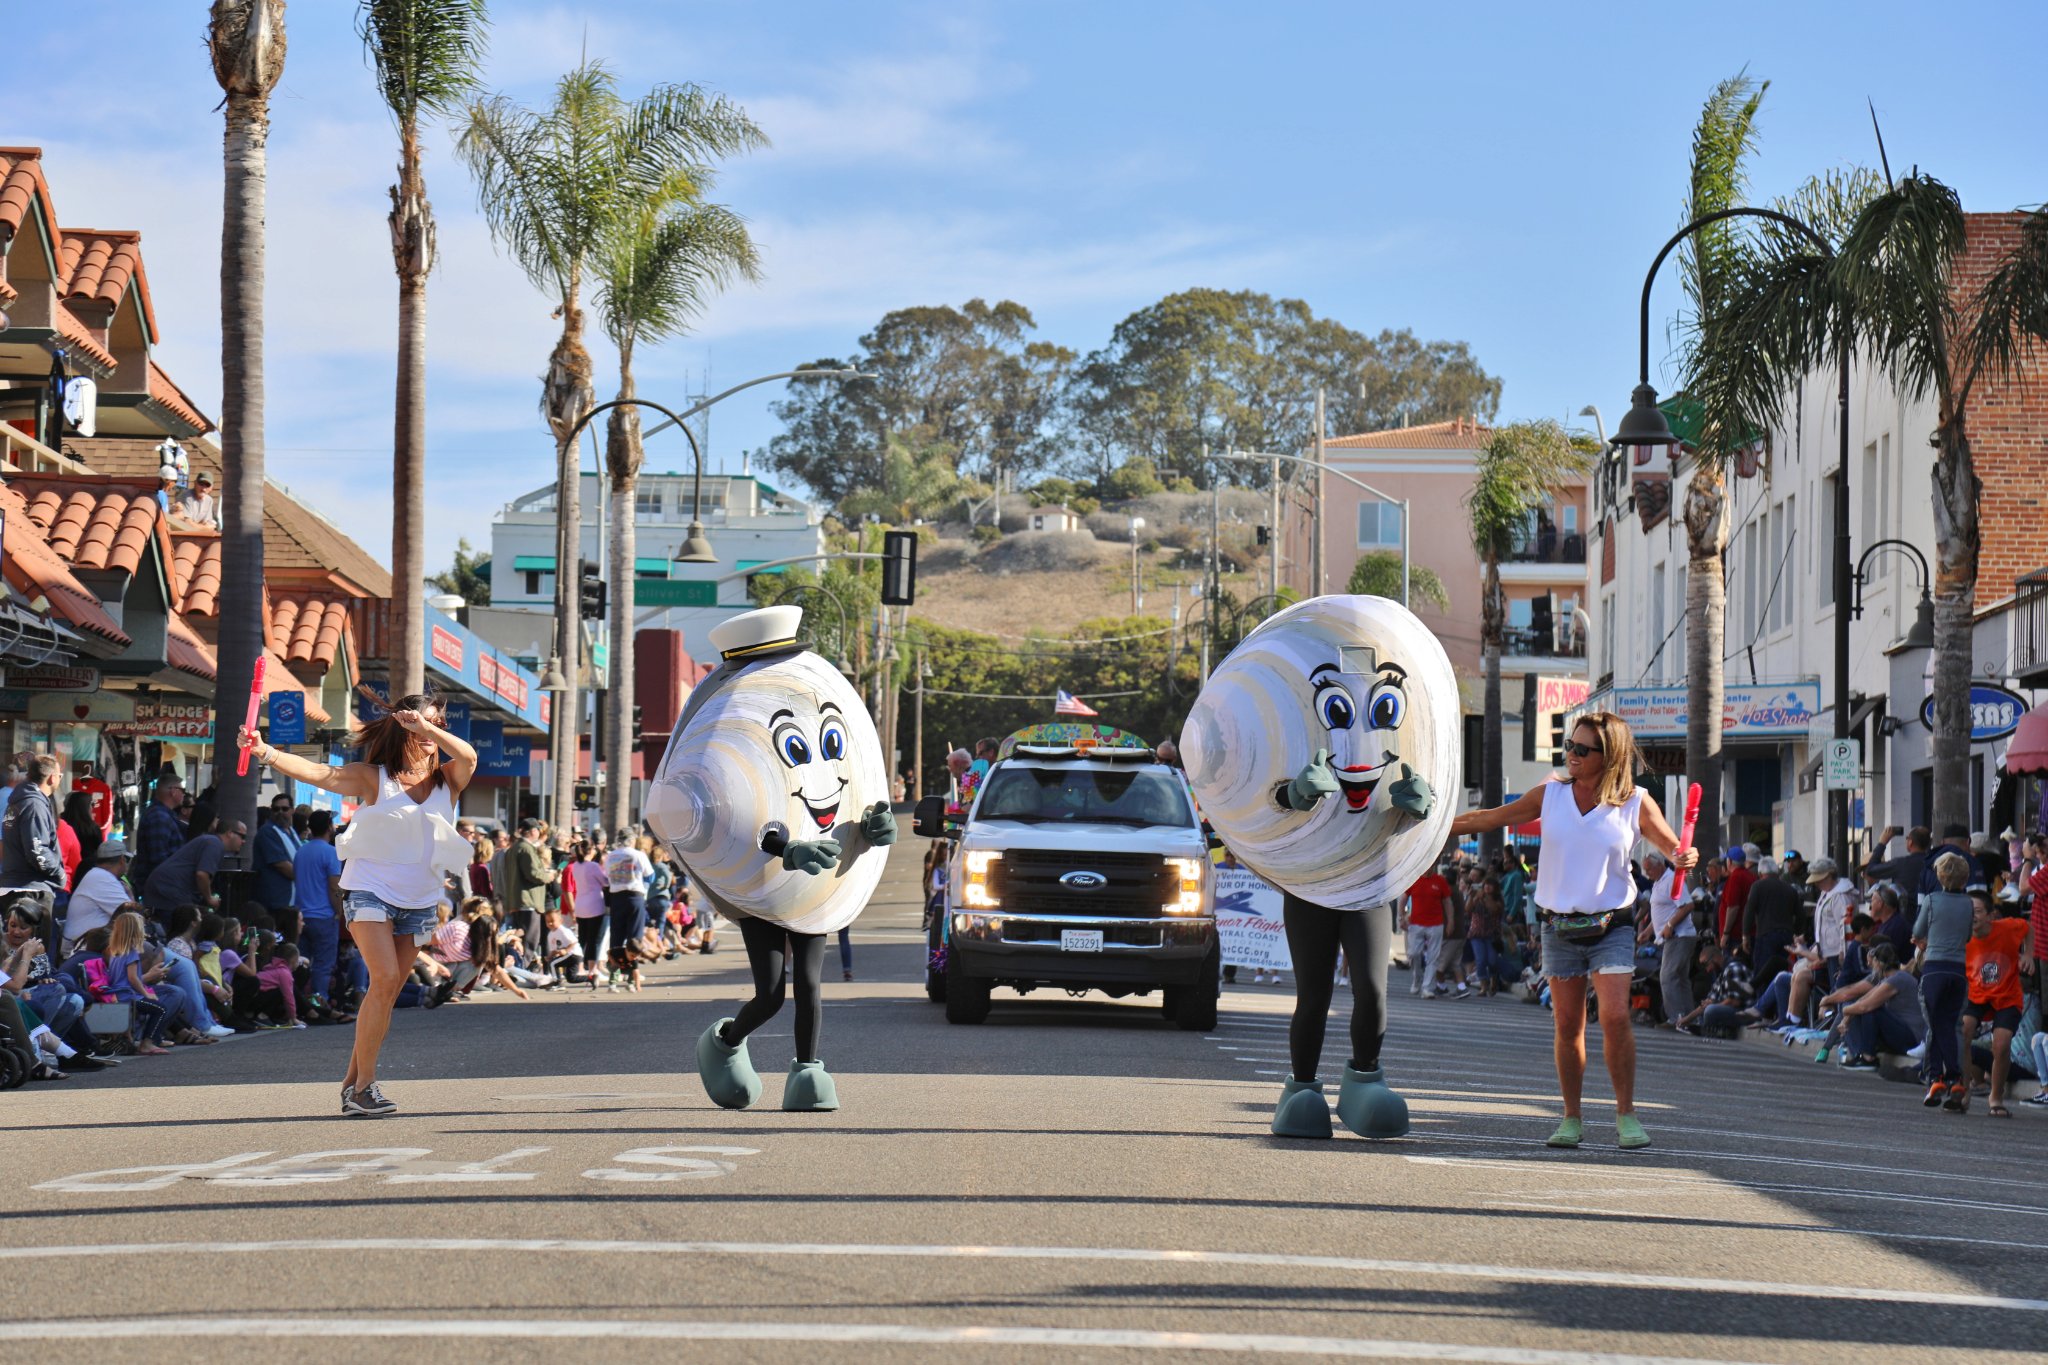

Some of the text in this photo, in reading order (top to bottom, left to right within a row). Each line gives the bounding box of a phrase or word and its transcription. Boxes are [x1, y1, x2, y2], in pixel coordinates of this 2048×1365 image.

[638, 588, 702, 599] olliver St
[49, 669, 95, 680] GALLERY
[1619, 696, 1649, 707] Family
[136, 705, 154, 717] SH
[160, 704, 204, 718] FUDGE
[1740, 704, 1769, 727] Hot
[1970, 702, 2014, 728] SAS
[157, 721, 208, 734] TAFFY
[504, 747, 524, 756] Left
[1838, 746, 1848, 757] P
[1646, 751, 1686, 767] PIZZA
[1072, 876, 1095, 885] Ford
[1221, 872, 1257, 880] Veterans
[1216, 881, 1233, 889] OUR
[1234, 881, 1245, 889] OF
[1215, 916, 1285, 933] onor Flight
[1219, 929, 1279, 942] NTRAL COAST
[1064, 937, 1100, 949] 1523291
[1222, 945, 1270, 959] htCCC.org
